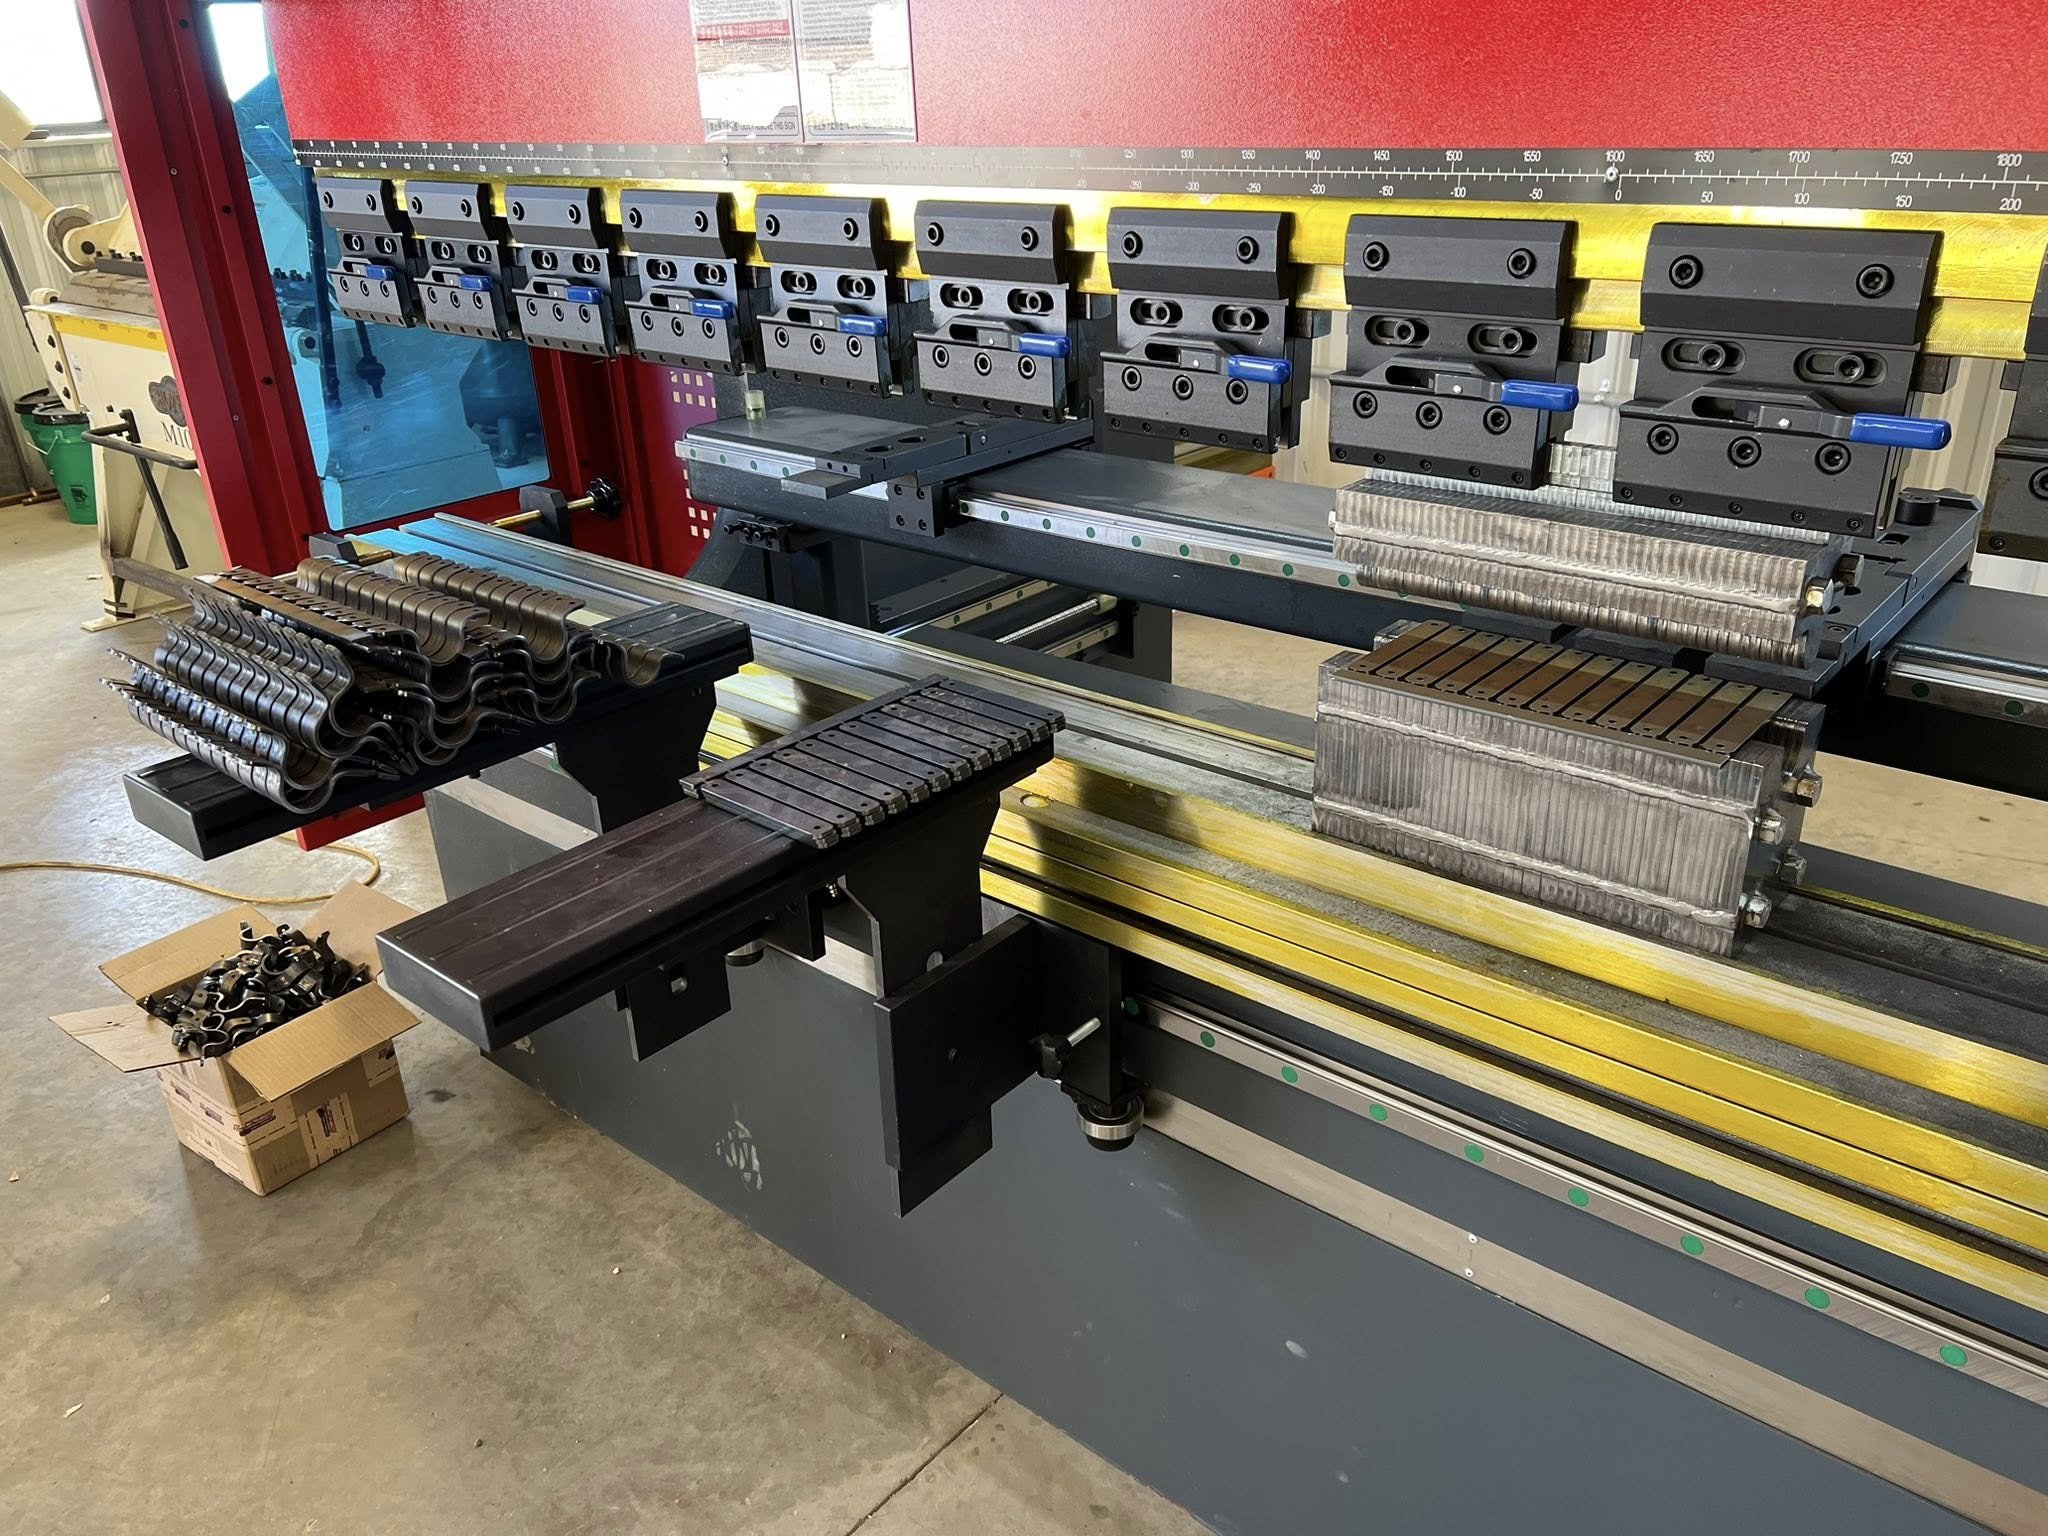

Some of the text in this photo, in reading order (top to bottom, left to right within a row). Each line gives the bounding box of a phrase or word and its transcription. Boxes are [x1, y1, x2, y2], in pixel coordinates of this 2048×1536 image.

[785, 121, 796, 130] SIGN
[1180, 149, 1195, 159] 1300
[1241, 149, 1256, 160] 1350
[1304, 149, 1321, 160] 1400
[1445, 150, 1463, 161] 1500
[1523, 150, 1541, 162] 1550
[1605, 150, 1625, 162] 1600
[1694, 150, 1715, 163] 1650
[1788, 150, 1811, 164] 1700
[1890, 151, 1914, 165] 1750
[1996, 153, 2023, 167] 1800
[1185, 181, 1200, 191] -300
[1246, 182, 1261, 193] -250
[1309, 184, 1326, 195] -200
[1378, 185, 1394, 196] -150
[1450, 186, 1467, 198] -100
[1528, 188, 1543, 200] -50
[1614, 189, 1622, 202] 0
[1700, 191, 1714, 203] 50
[1793, 192, 1810, 205] 100
[1895, 194, 1913, 208] 150
[1999, 197, 2023, 212] 200
